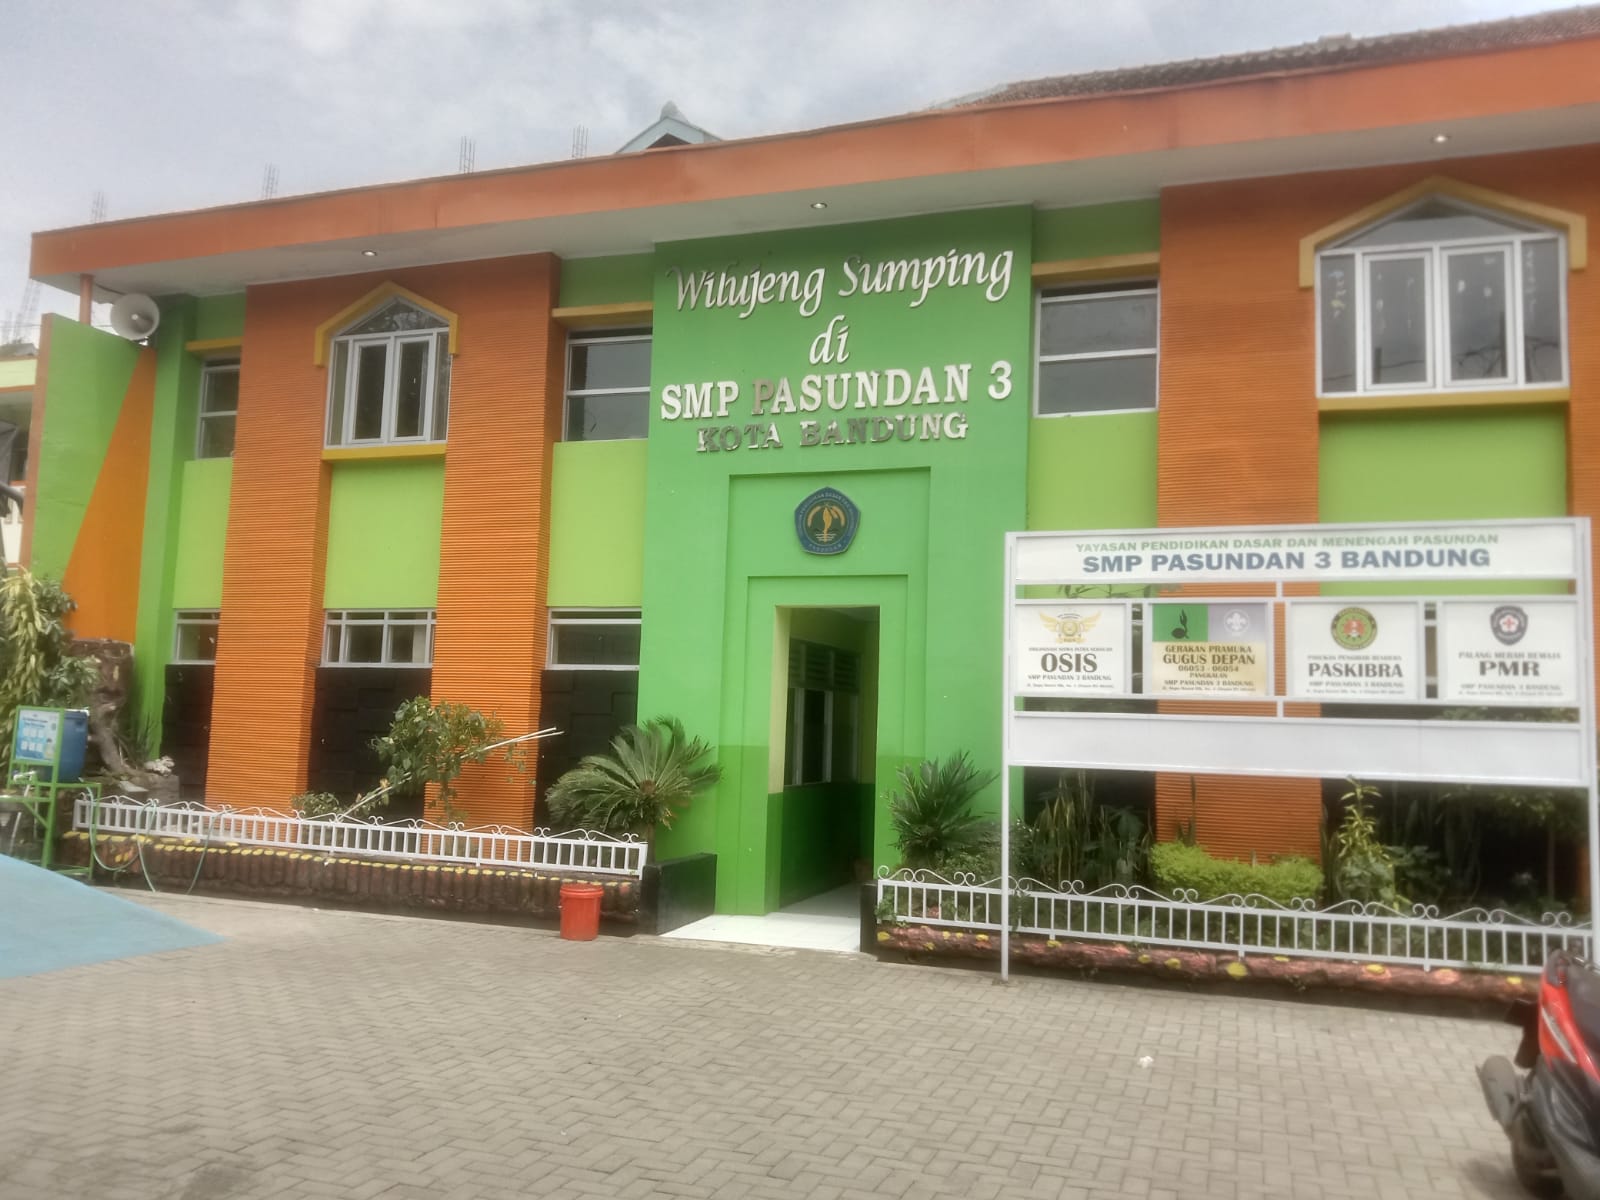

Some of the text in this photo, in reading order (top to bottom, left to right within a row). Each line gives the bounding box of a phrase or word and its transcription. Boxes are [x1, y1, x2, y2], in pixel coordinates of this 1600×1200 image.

[667, 249, 1014, 318] Wilujeng Sumping
[809, 315, 849, 364] di
[660, 360, 1012, 420] SMP PASUNDAN 3
[696, 412, 969, 453] KOTA BANDUNG
[1076, 534, 1499, 553] YAYASAN PENDIDIKAN DASAR DAN MENENGAH PASUNDAN
[1083, 549, 1490, 573] SMP PASUNDAN 3 BANDUNG
[1165, 645, 1206, 653] GERAKAN
[1040, 653, 1097, 673] OSIS
[1163, 654, 1255, 665] GUGUS DEPAN
[1479, 661, 1540, 676] PMR
[1308, 663, 1403, 677] PASKIBRA
